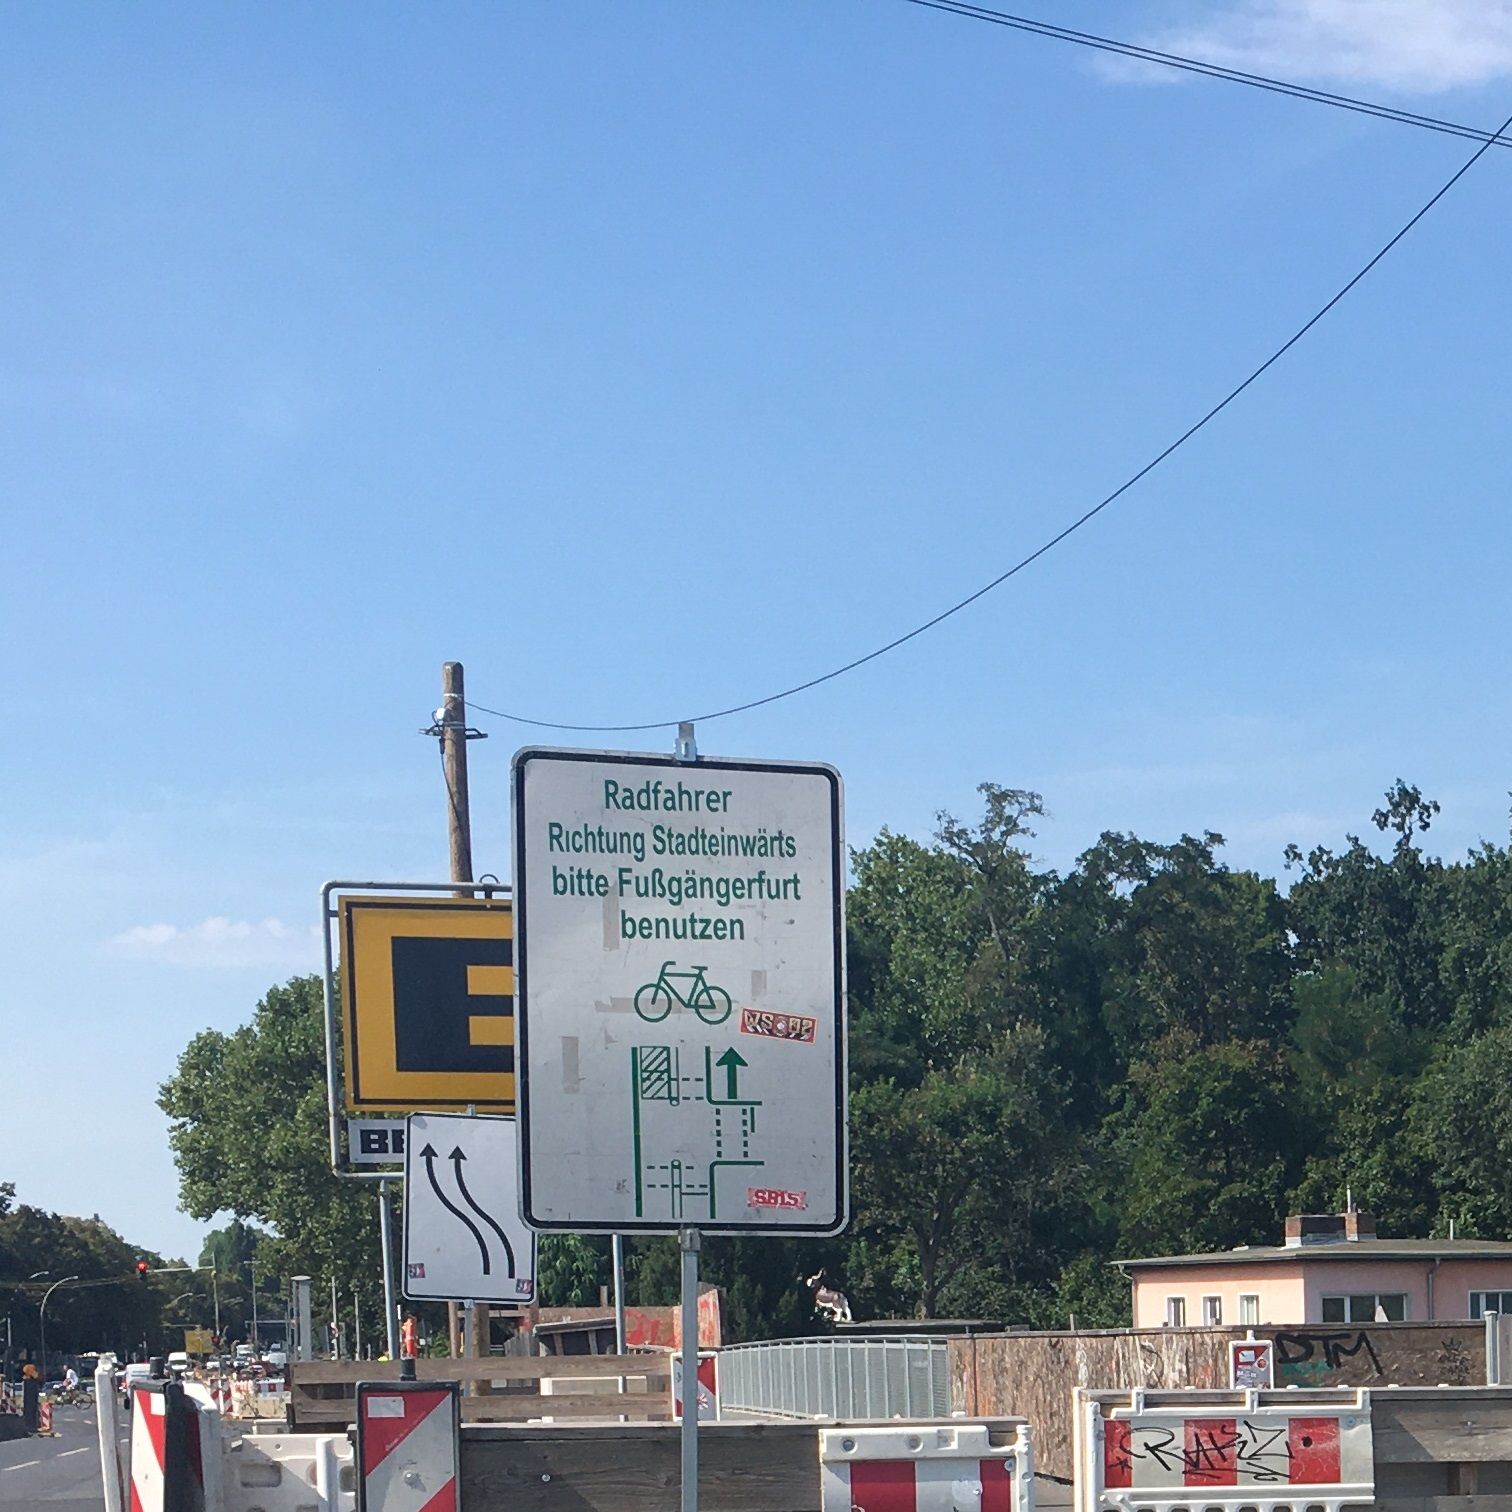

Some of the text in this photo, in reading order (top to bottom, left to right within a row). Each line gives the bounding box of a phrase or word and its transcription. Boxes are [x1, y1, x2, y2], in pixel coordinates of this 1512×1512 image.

[604, 779, 732, 812] Radfahrer
[548, 822, 797, 862] Richtung Stadteinwärts
[552, 866, 802, 907] bitte Fußgängerfurt
[620, 909, 745, 940] benutzen
[1276, 1331, 1383, 1376] DTM
